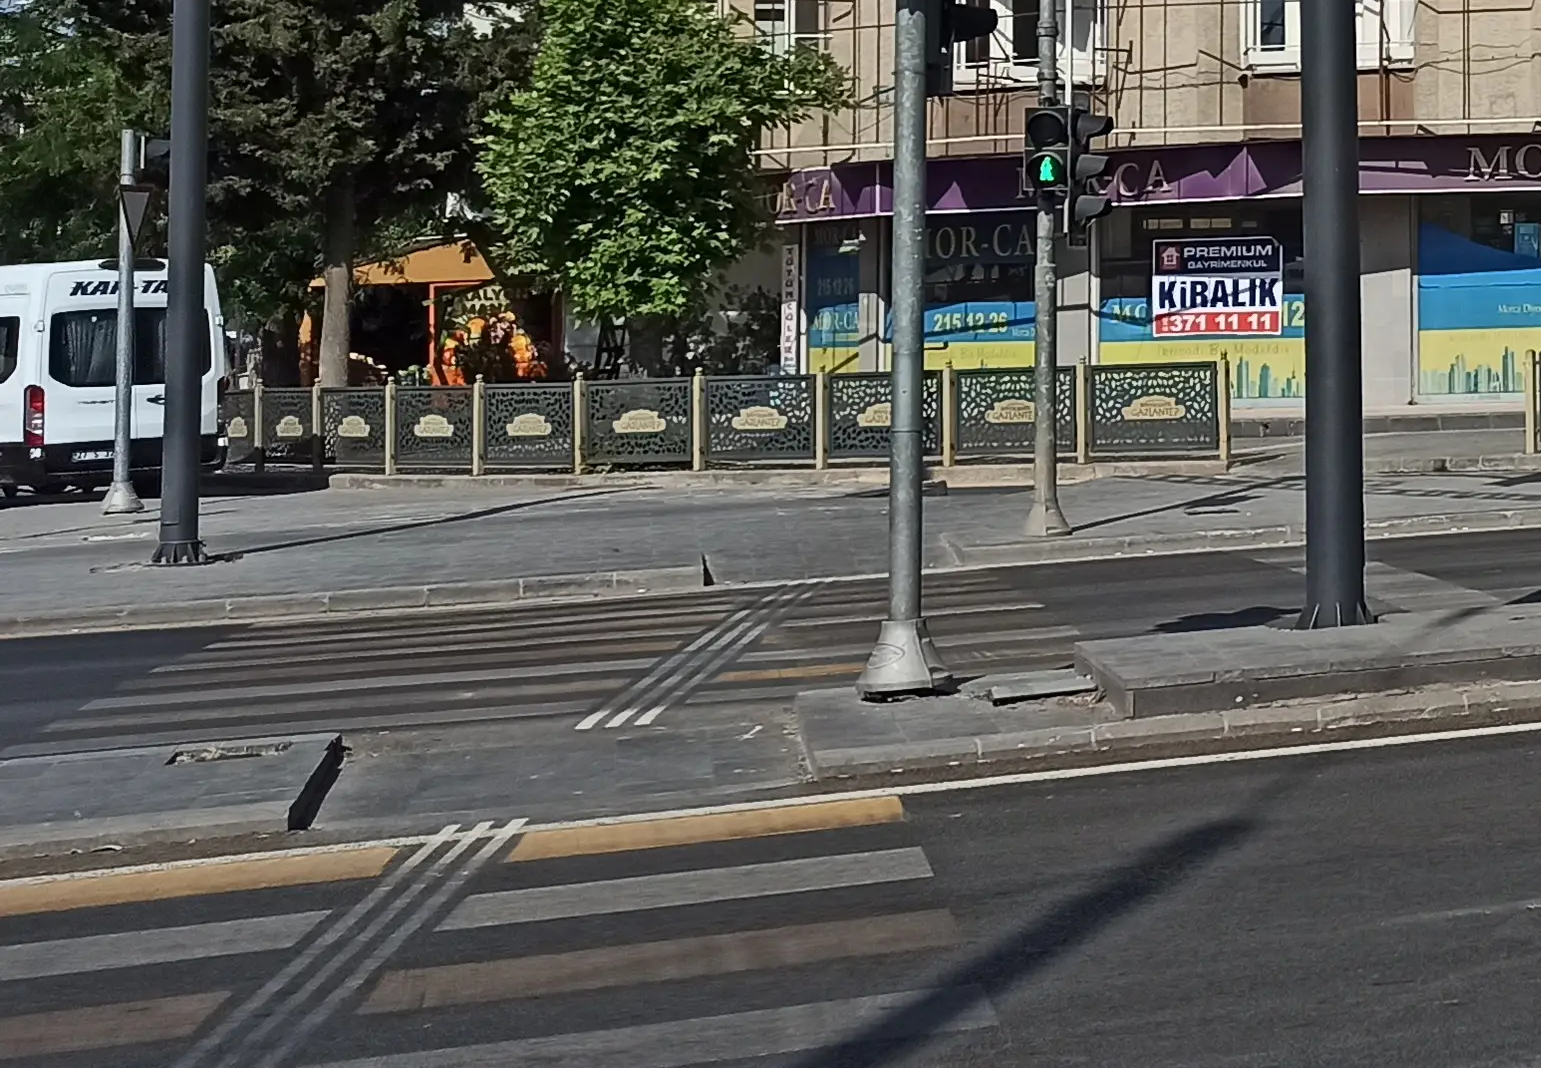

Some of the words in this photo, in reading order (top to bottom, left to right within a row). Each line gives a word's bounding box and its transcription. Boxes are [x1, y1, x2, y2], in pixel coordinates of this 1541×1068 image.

[1183, 245, 1272, 259] PREMIUM
[1187, 258, 1267, 270] GAYRİMENKUL
[1171, 313, 1208, 332] 371
[1214, 313, 1239, 331] 11
[1247, 313, 1272, 330] 11
